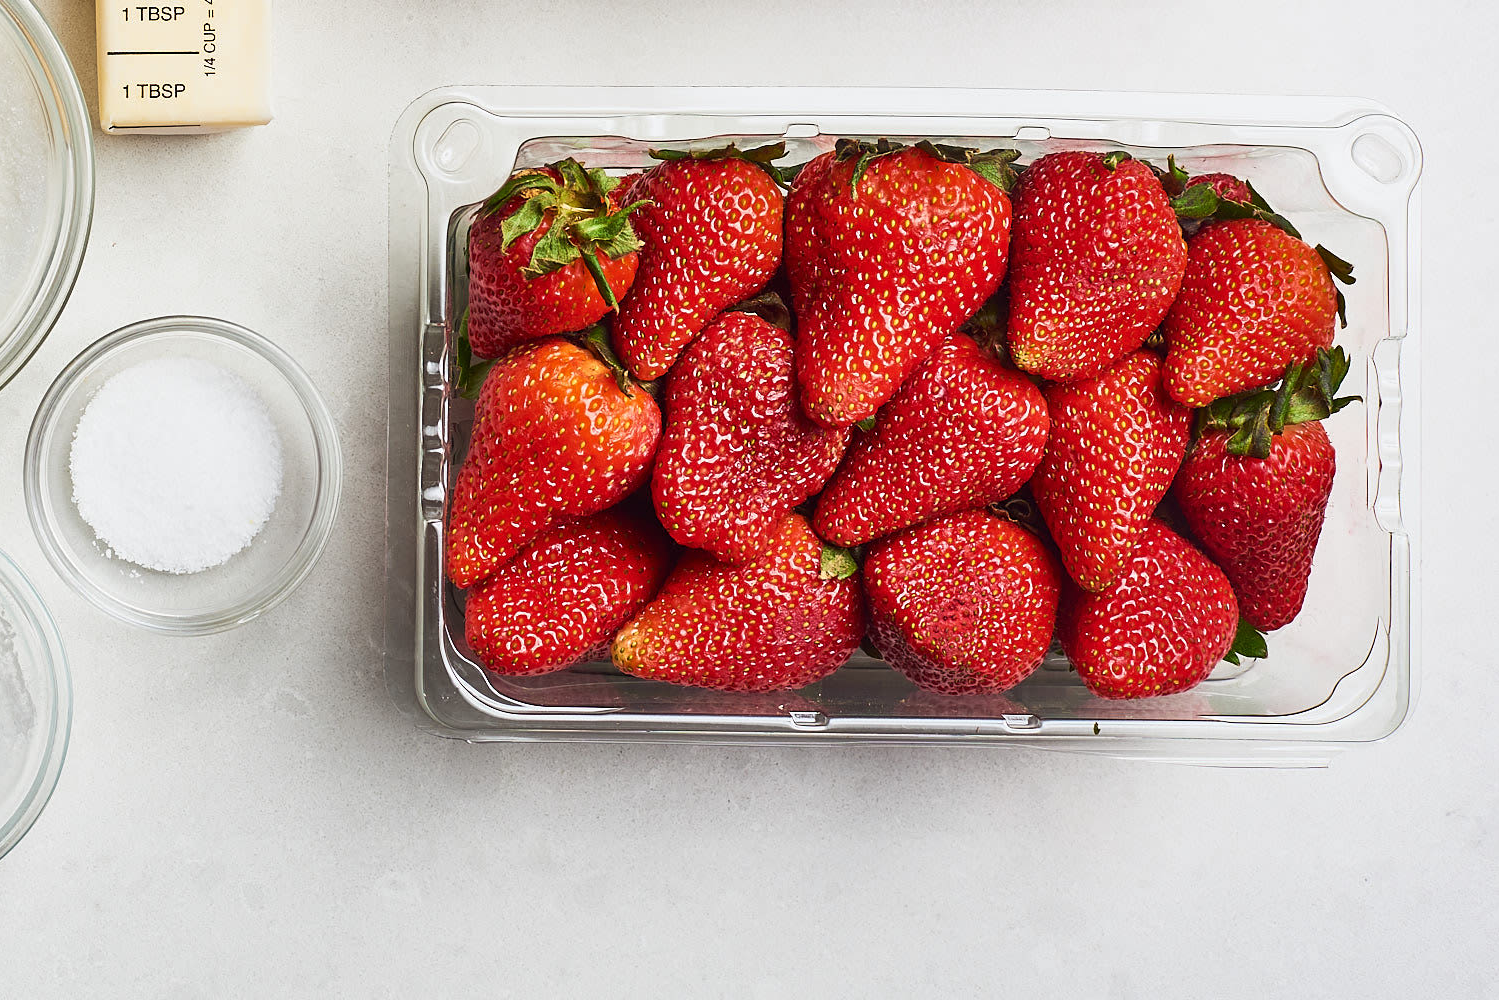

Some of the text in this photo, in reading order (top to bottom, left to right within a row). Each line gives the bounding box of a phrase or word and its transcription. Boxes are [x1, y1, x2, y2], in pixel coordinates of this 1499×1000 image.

[122, 6, 185, 22] 1 TBSP
[202, 22, 216, 55] CUP
[202, 57, 216, 77] 1/4
[122, 83, 186, 99] 1 TBSP
